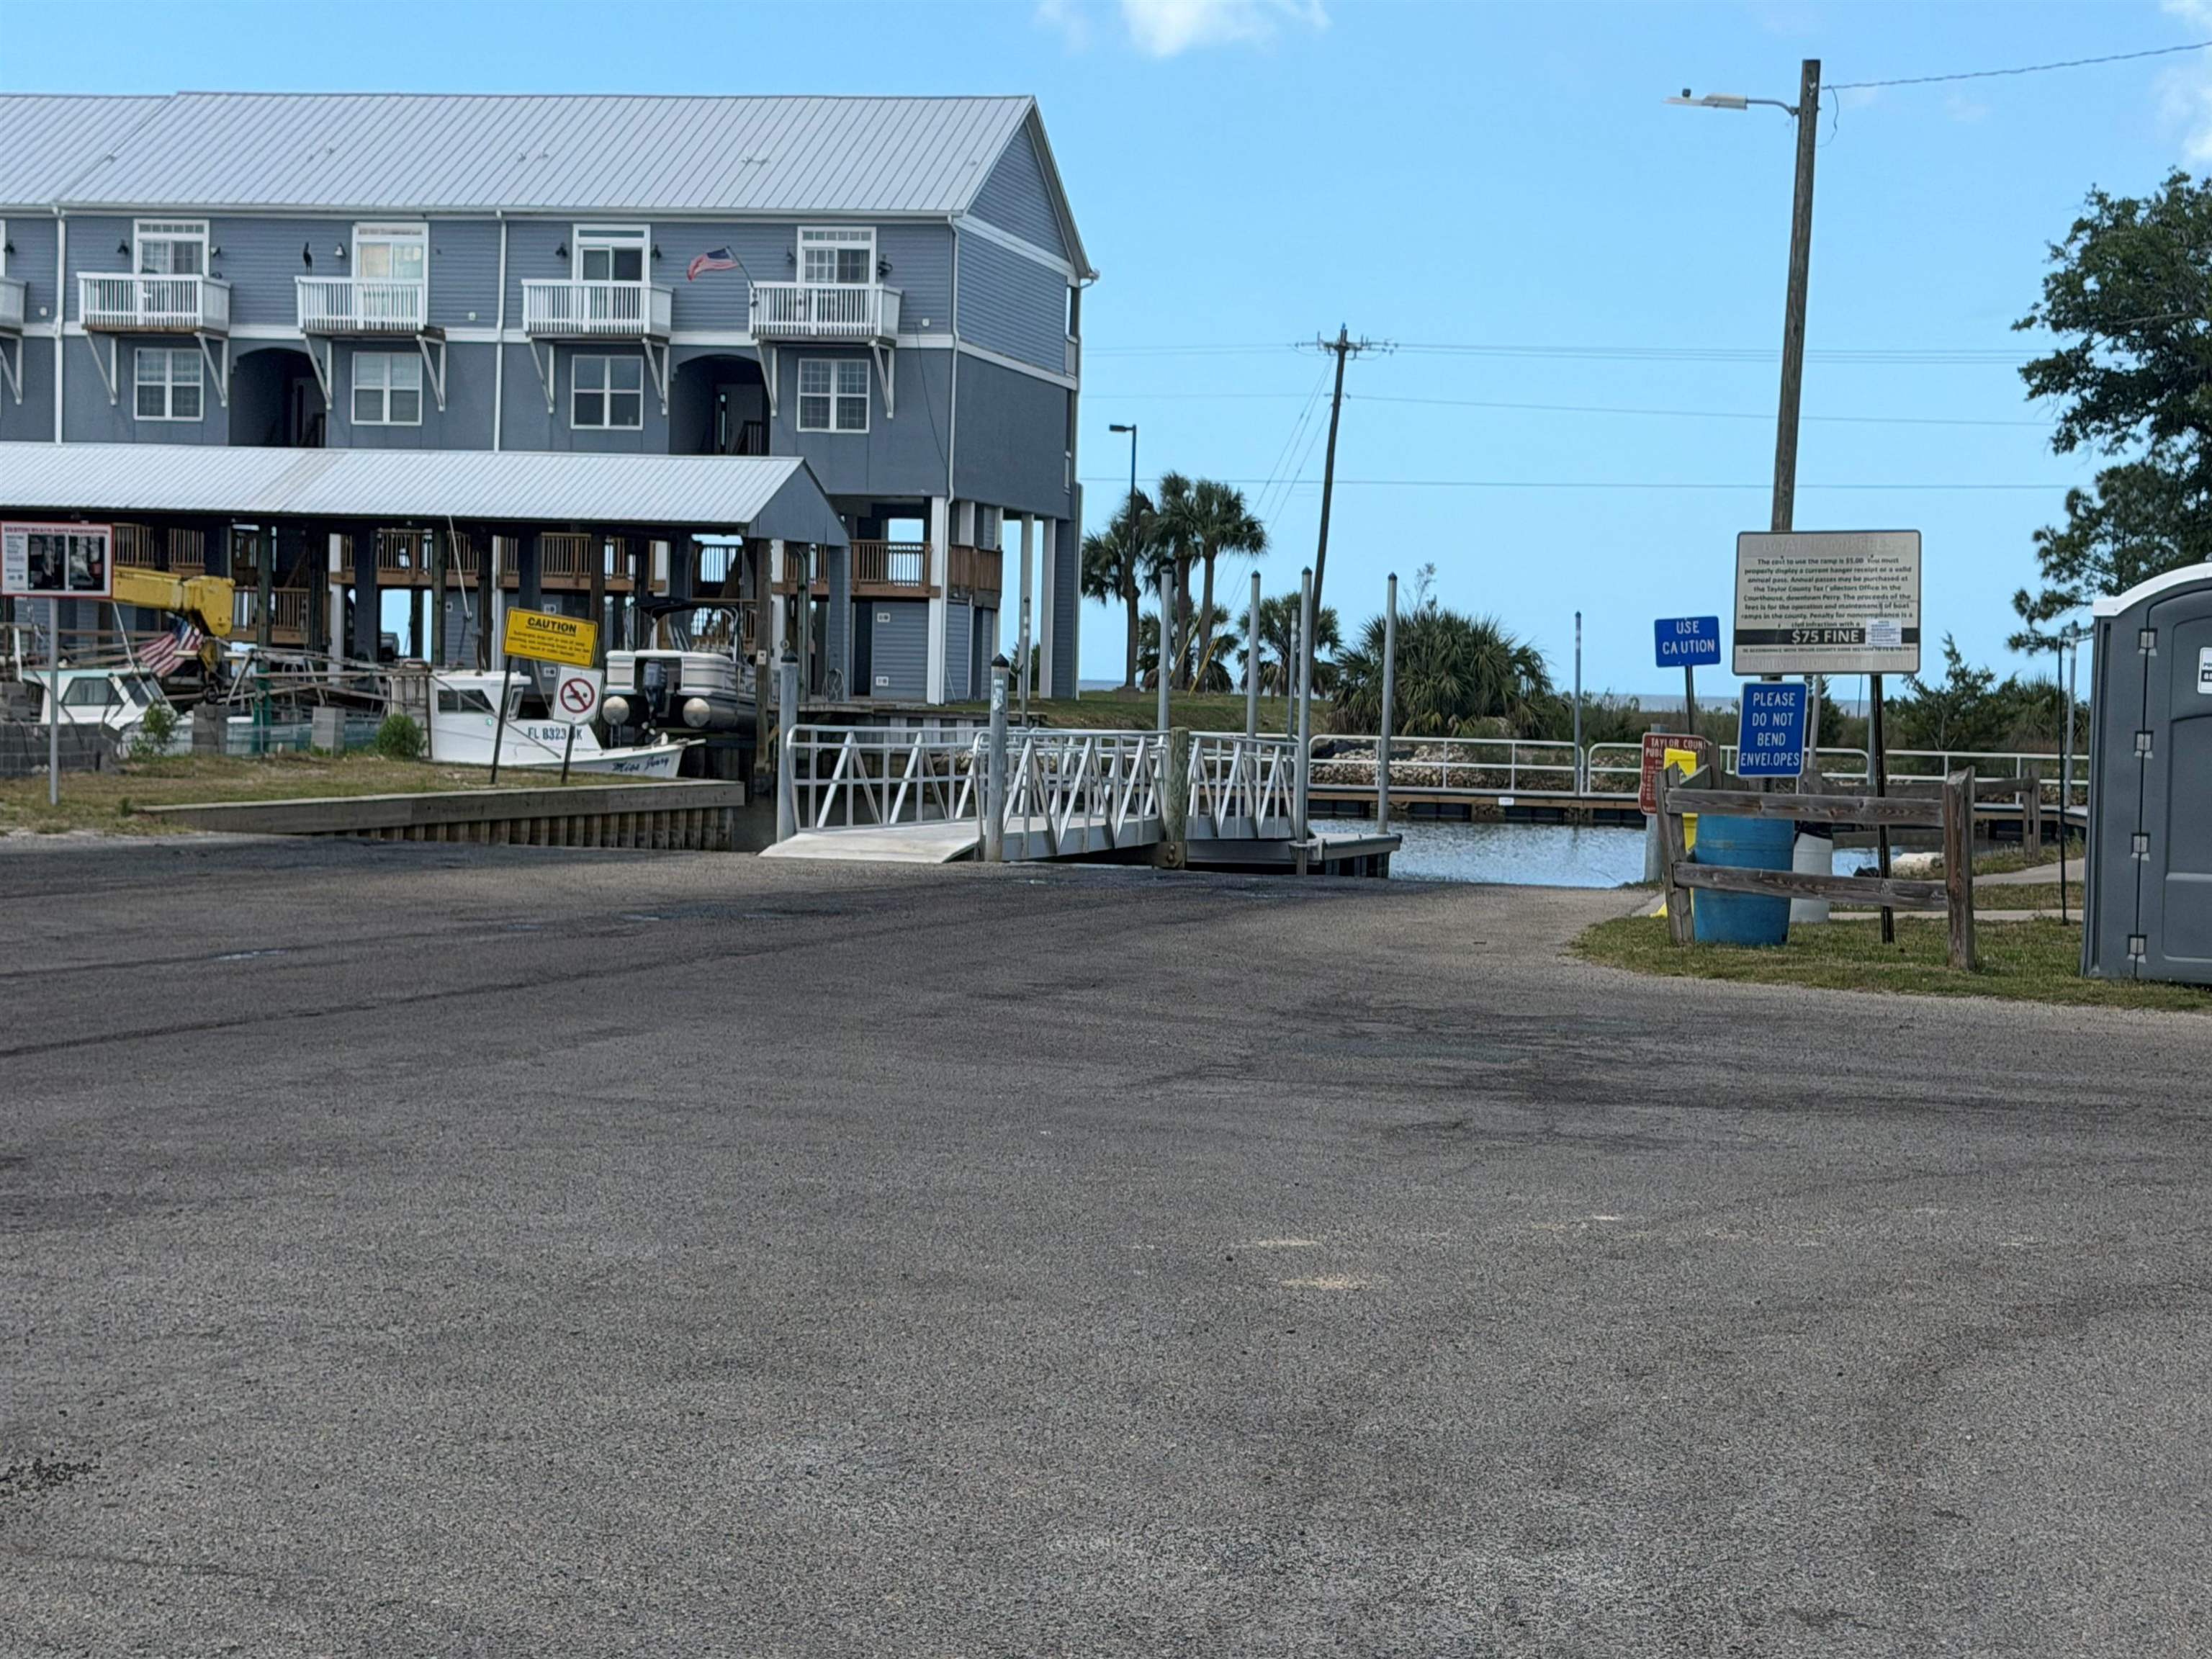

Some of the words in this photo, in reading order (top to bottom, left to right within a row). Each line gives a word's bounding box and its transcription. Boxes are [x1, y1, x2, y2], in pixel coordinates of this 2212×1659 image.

[527, 617, 577, 634] CAUTION
[1676, 620, 1699, 634] USE
[1791, 629, 1819, 645] $75
[1824, 629, 1859, 643] FINE
[1662, 639, 1715, 655] CAUTION
[1753, 692, 1796, 707] PLEASE
[1752, 712, 1767, 727] DO
[1772, 712, 1794, 727] NOT
[528, 726, 539, 739] FL
[1757, 732, 1786, 747] BEND
[1650, 737, 1679, 748] TAYLOR
[1645, 747, 1663, 758] PUBL
[1740, 752, 1800, 767] ENVELOPES
